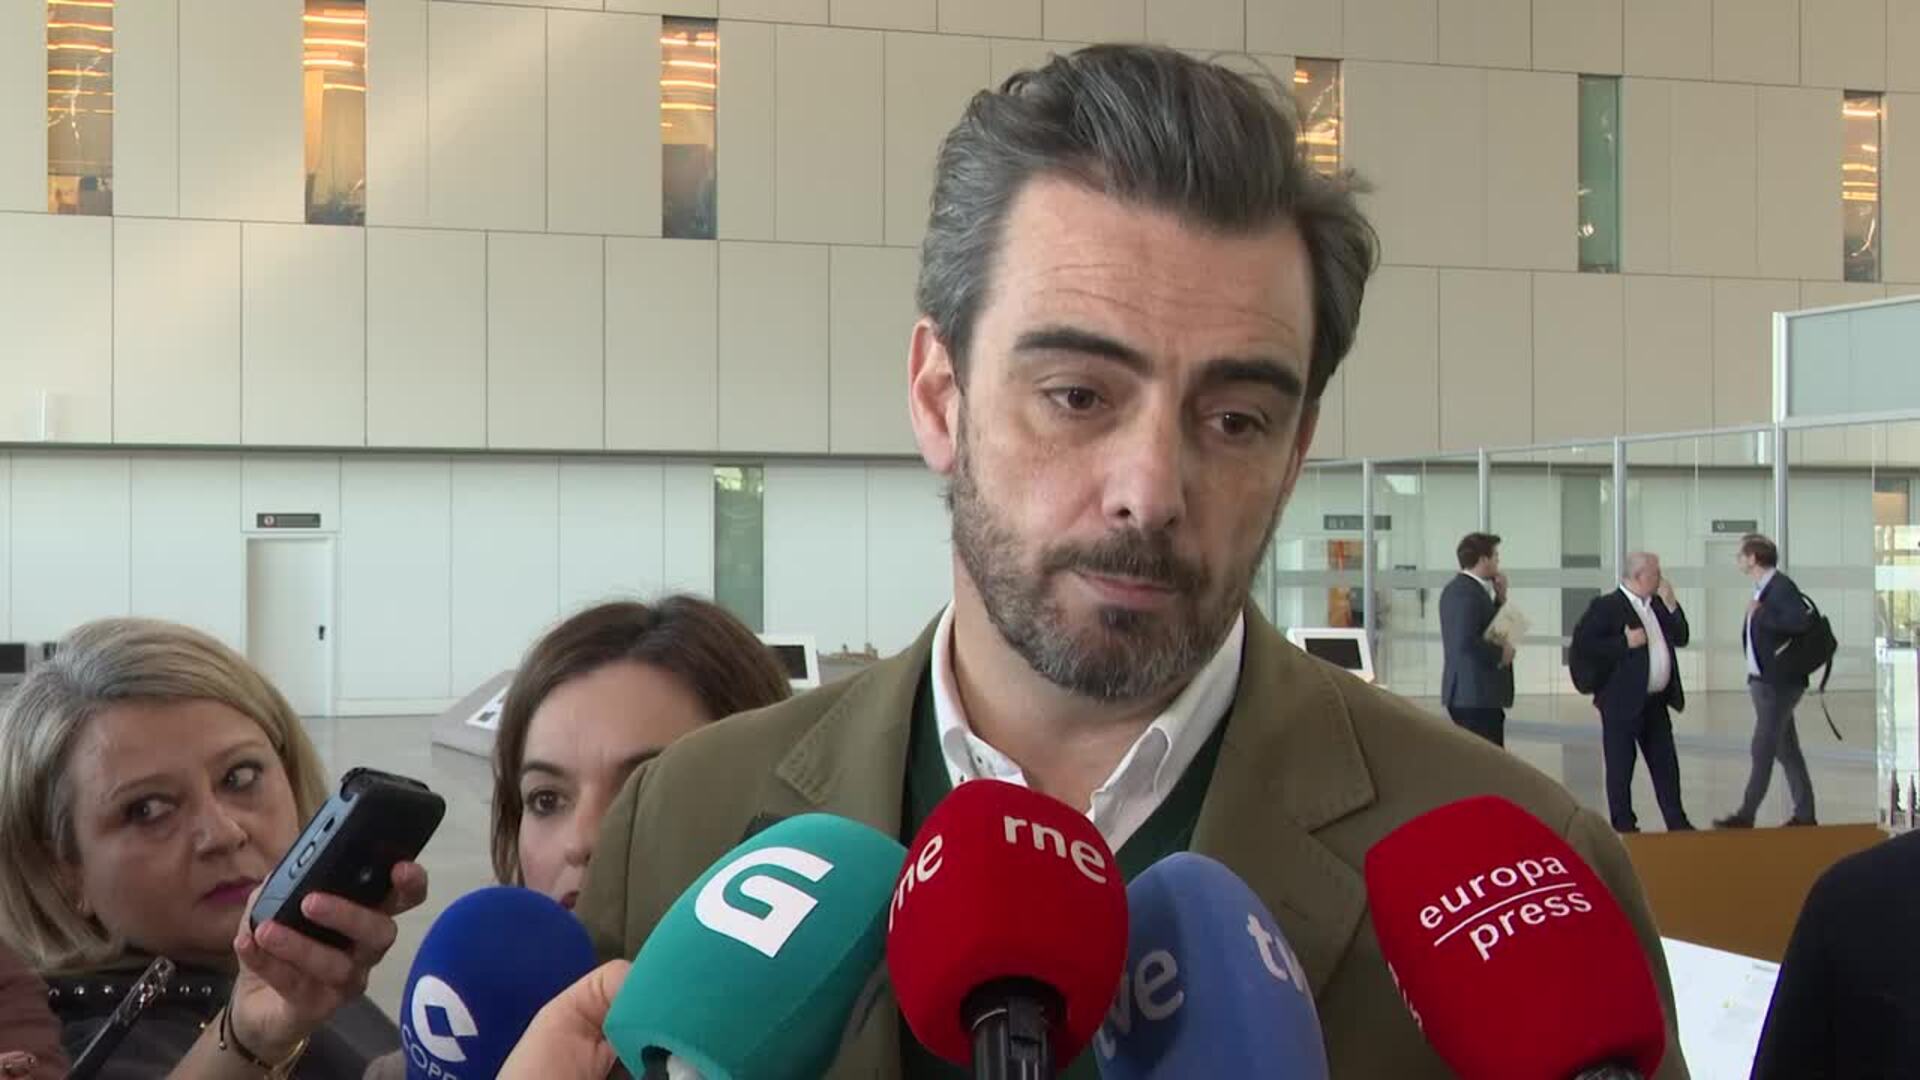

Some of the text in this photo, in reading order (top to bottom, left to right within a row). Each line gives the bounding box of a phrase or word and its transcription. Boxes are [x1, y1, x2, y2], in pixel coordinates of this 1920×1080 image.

[1004, 815, 1107, 884] rne
[1419, 856, 1568, 929] europa
[1469, 892, 1592, 962] press
